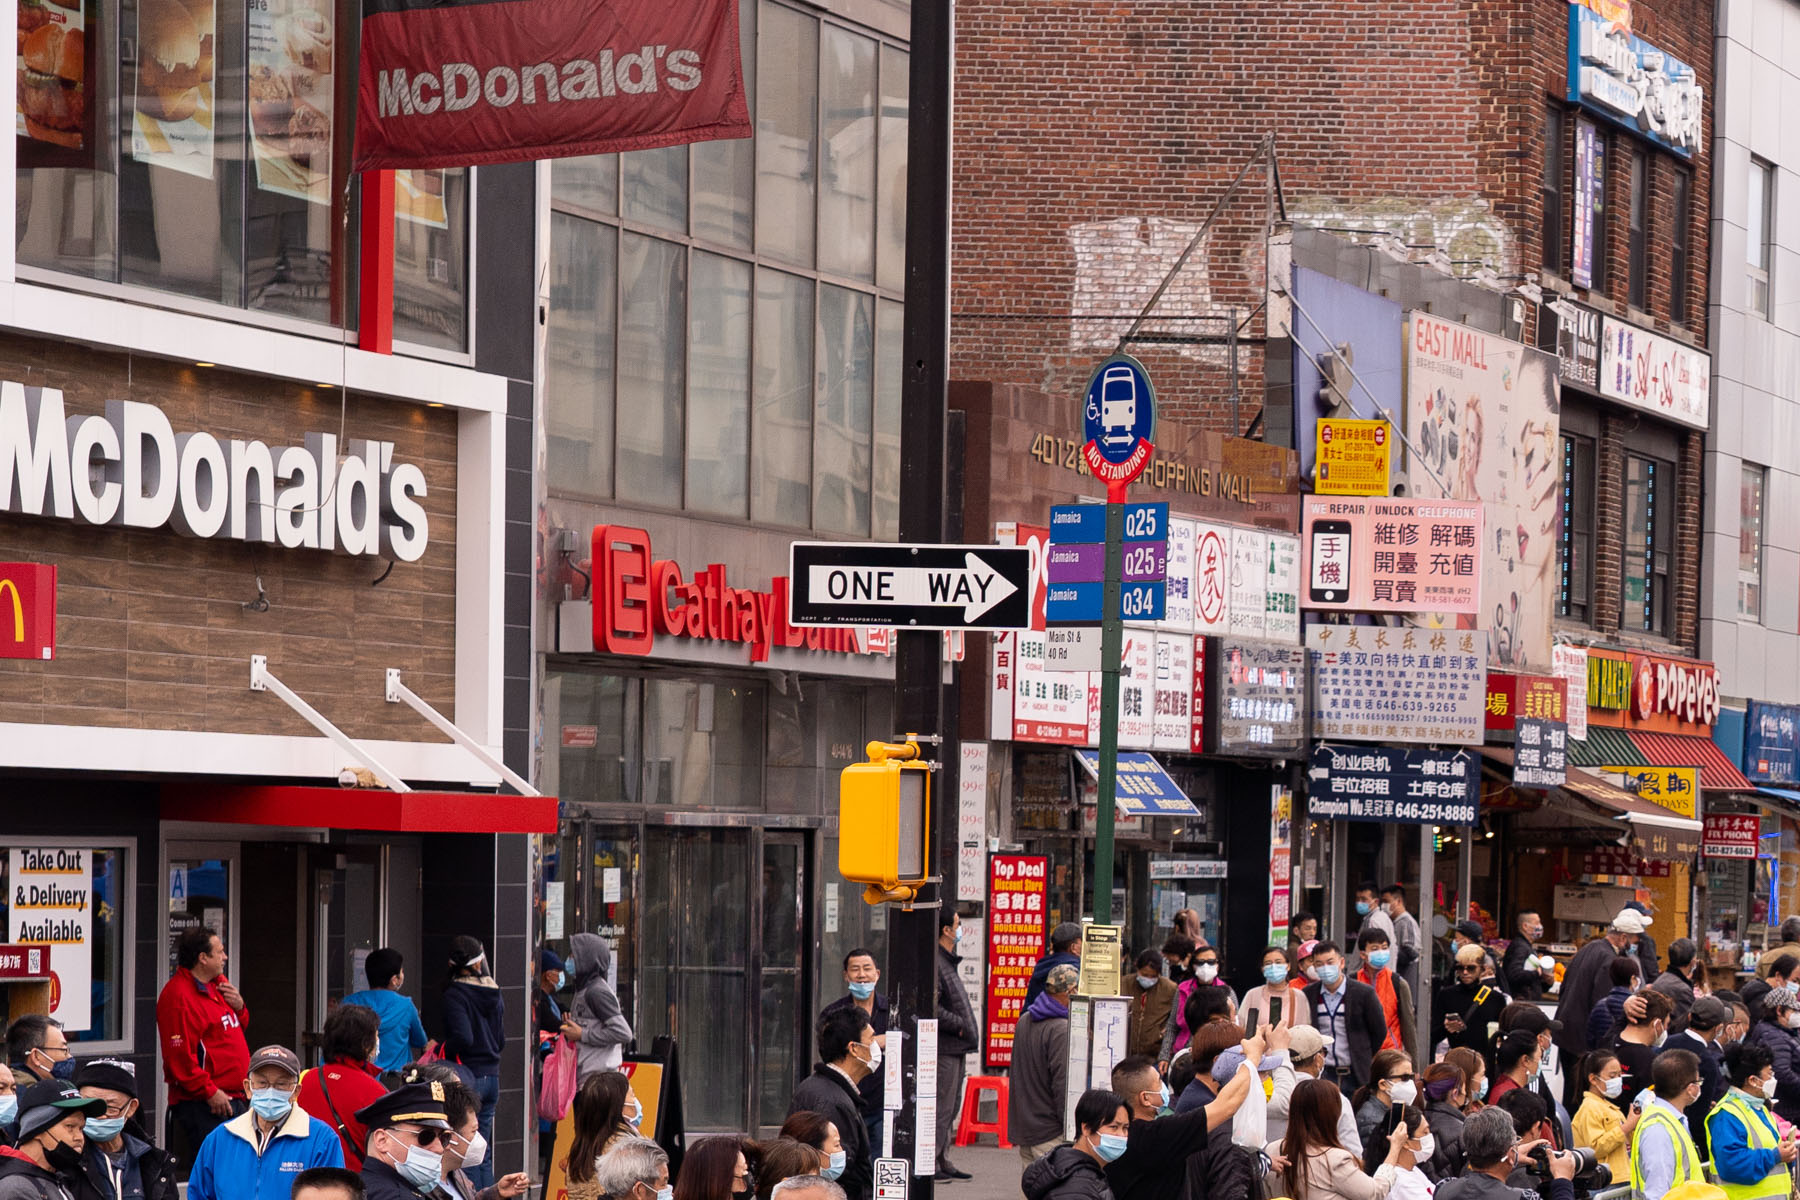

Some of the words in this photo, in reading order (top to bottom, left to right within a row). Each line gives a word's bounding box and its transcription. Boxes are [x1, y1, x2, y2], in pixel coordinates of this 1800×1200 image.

[378, 44, 702, 119] McDonald's
[1415, 318, 1449, 358] EAST
[1451, 329, 1488, 371] MALL
[0, 380, 429, 562] McDonald's
[1031, 432, 1077, 470] 4012
[1134, 458, 1212, 497] HOPPING
[1218, 472, 1257, 504] MALL
[1086, 446, 1101, 469] NO
[1100, 444, 1147, 481] STANDING
[1053, 511, 1082, 524] Jamaica
[1126, 508, 1157, 538] Q25
[1310, 503, 1327, 515] WE
[1329, 503, 1365, 515] REPAIR
[1375, 505, 1415, 517] UNLOCK
[1416, 506, 1478, 520] CELLPHONE
[1373, 521, 1420, 546] 維修
[1429, 523, 1476, 548] 解碼
[1051, 550, 1079, 563] Jamaica
[1124, 547, 1155, 577] Q25
[1319, 536, 1342, 585] 手機
[1373, 551, 1418, 575] 開臺
[1429, 552, 1475, 577] 充值
[827, 569, 895, 602] ONE
[928, 572, 995, 603] WAY
[1372, 578, 1417, 603] 買賣
[651, 562, 777, 662] Cathay
[1048, 589, 1078, 601] Jamaica
[1122, 587, 1153, 616] Q34
[1048, 631, 1067, 643] Main
[1067, 631, 1075, 643] St
[1076, 632, 1082, 642] &
[1048, 648, 1058, 660] 40
[1059, 648, 1068, 660] Rd
[1485, 692, 1509, 716] 場
[1330, 755, 1391, 773] 创业良机
[1330, 776, 1390, 795] 吉位招租
[1636, 771, 1692, 796] 假期
[1308, 795, 1350, 818] Champion
[1350, 799, 1363, 815] Wu
[1395, 802, 1475, 822] 646-251-8886
[1707, 830, 1721, 839] FIX
[1722, 830, 1753, 840] PHONE
[20, 849, 54, 870] Take
[56, 850, 82, 870] Out
[994, 859, 1015, 880] Top
[1017, 860, 1045, 877] Deal
[171, 868, 184, 898] A
[994, 878, 1024, 891] Discount
[1024, 878, 1043, 892] Store
[15, 886, 27, 906] &
[29, 884, 87, 912] Delivery
[995, 892, 1042, 911] 百貨店
[19, 920, 83, 943] Available
[993, 923, 1042, 934] HOUSEWARES
[996, 945, 1039, 955] STATIONARY
[993, 965, 1020, 976] JAPANESE
[1020, 966, 1035, 976] ITE
